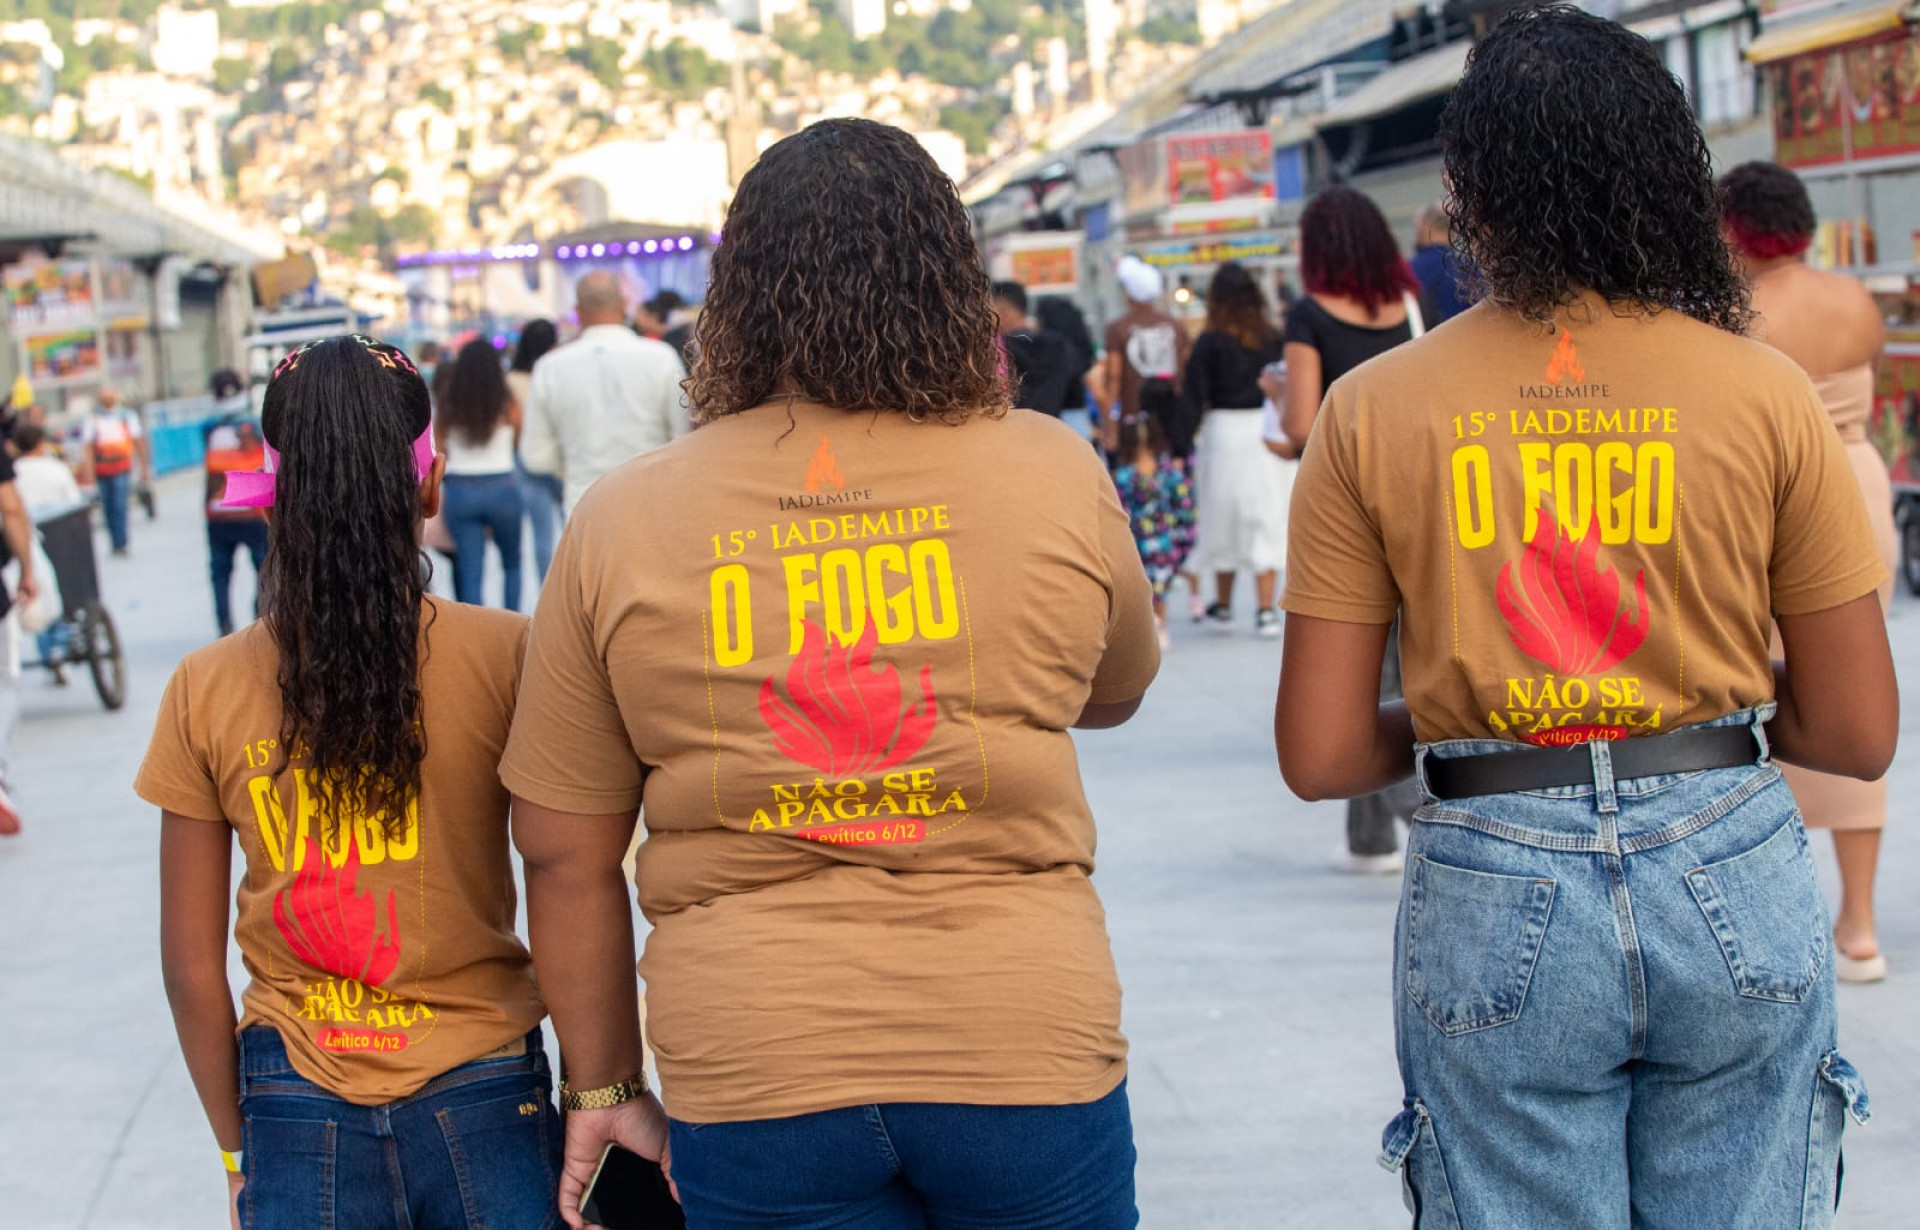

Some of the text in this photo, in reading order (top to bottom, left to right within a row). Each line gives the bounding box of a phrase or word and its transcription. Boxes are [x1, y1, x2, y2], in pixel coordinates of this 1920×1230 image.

[1519, 383, 1611, 399] IADEMIPE
[1509, 407, 1679, 435] IADEMIPE
[778, 489, 873, 511] IADEMIPE
[1452, 441, 1675, 550] O FOGO
[770, 504, 951, 550] IADEMIPE
[710, 538, 960, 668] O FOGO
[1506, 673, 1645, 709] NÃO SE
[882, 767, 937, 793] SE
[882, 823, 917, 842] 6/12
[373, 1034, 400, 1051] 6/12
